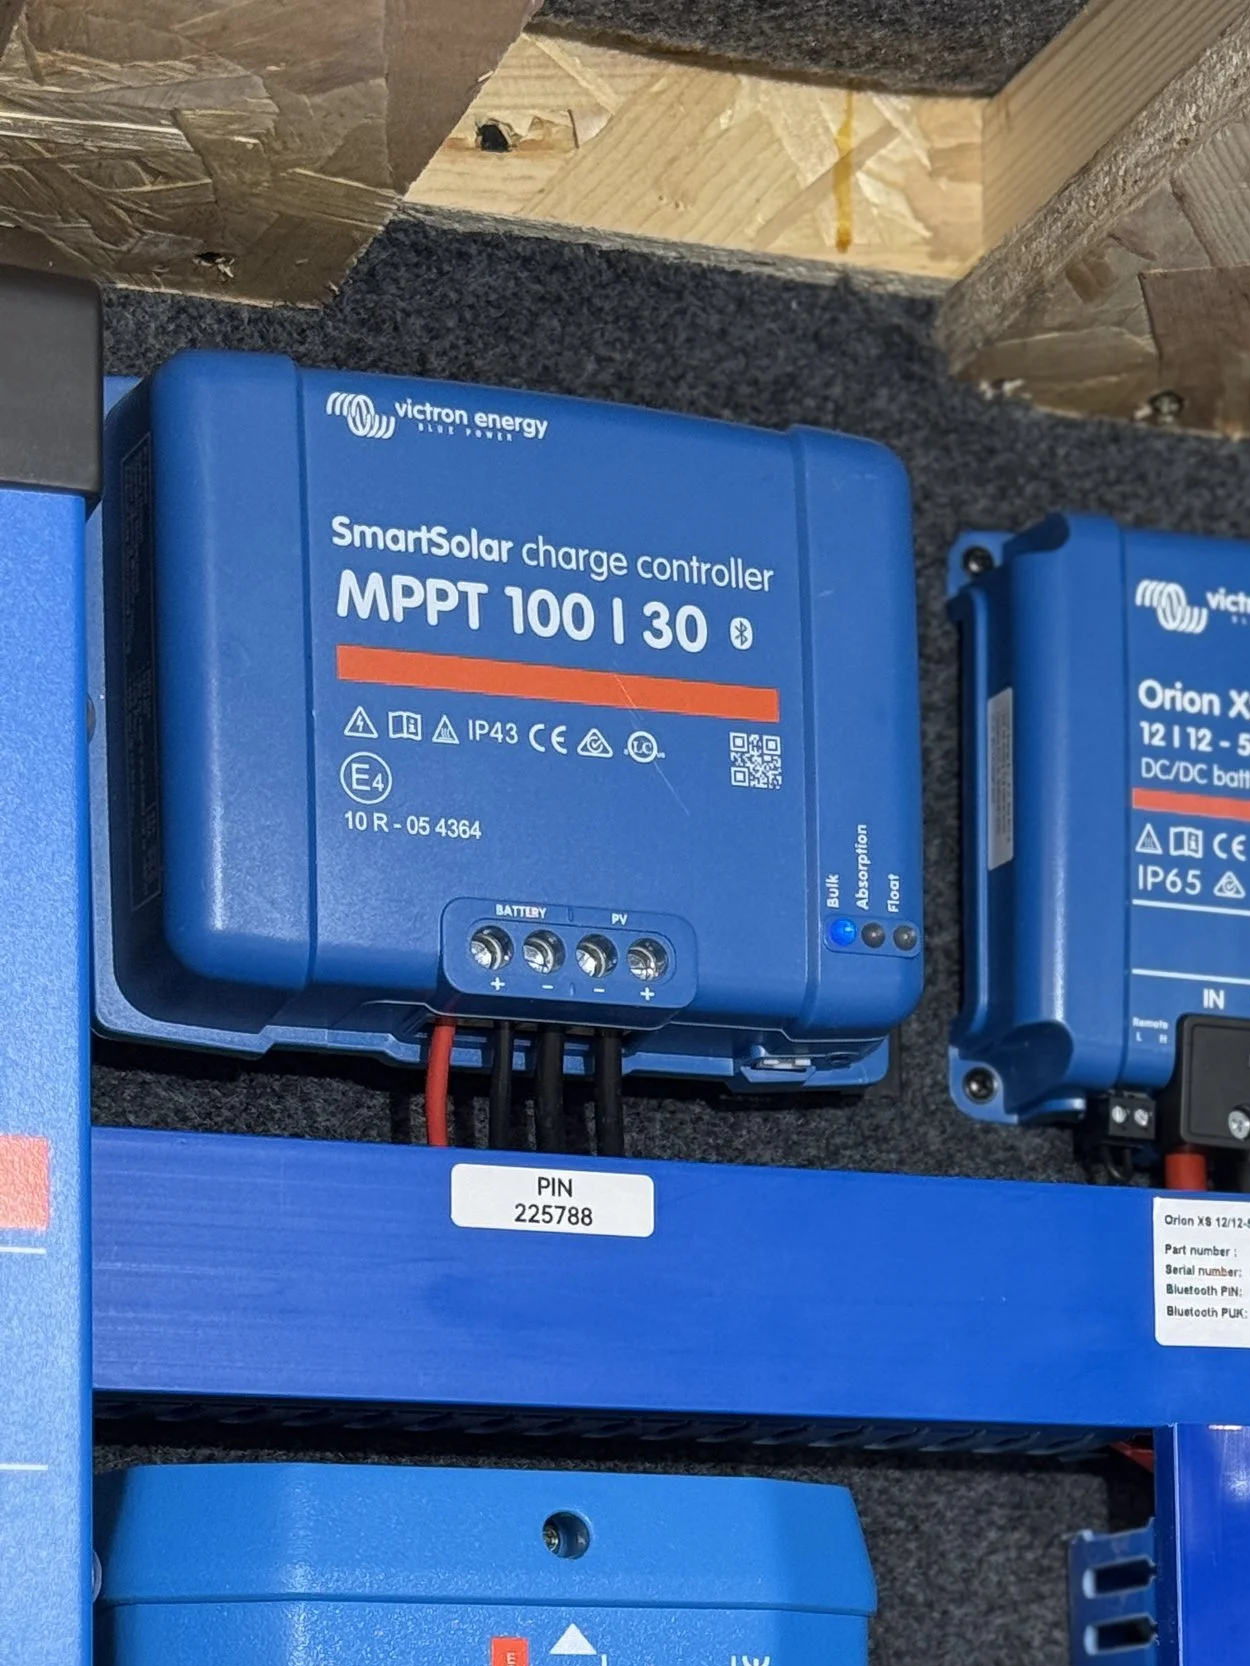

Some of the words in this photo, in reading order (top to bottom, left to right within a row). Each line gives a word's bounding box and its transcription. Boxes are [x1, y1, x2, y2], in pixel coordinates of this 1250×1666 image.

[394, 398, 467, 426] victron
[475, 411, 548, 440] energy
[418, 423, 454, 436] BLUE
[466, 428, 513, 442] POWER
[331, 515, 513, 563] SmartSolar
[522, 536, 627, 581] charge
[637, 554, 774, 593] controller
[337, 569, 488, 630] MPPT
[504, 585, 594, 641] 100
[642, 601, 707, 653] 30
[1138, 678, 1220, 716] Orion
[468, 719, 519, 745] IP43
[1140, 721, 1166, 747] 12
[1188, 727, 1213, 752] 12
[1141, 757, 1208, 785] DC/DC
[344, 811, 368, 831] 10
[373, 813, 389, 832] R
[406, 816, 430, 836] 05
[436, 818, 481, 840] 4364
[856, 824, 869, 910] Absorption
[1138, 865, 1202, 895] IP65
[827, 873, 839, 908] Bulk
[888, 873, 900, 913] Float
[495, 904, 547, 919] BATTERY
[611, 912, 628, 926] PV
[1203, 988, 1224, 1010] IN
[537, 1176, 573, 1198] PIN
[514, 1202, 593, 1227] 225788
[1164, 1215, 1194, 1228] Orion
[1197, 1216, 1212, 1229] XS
[1165, 1244, 1188, 1256] Part
[1190, 1245, 1230, 1258] number
[1165, 1263, 1195, 1276] Serial
[1166, 1283, 1218, 1297] Bluetooth
[1166, 1305, 1218, 1319] Bluetooth
